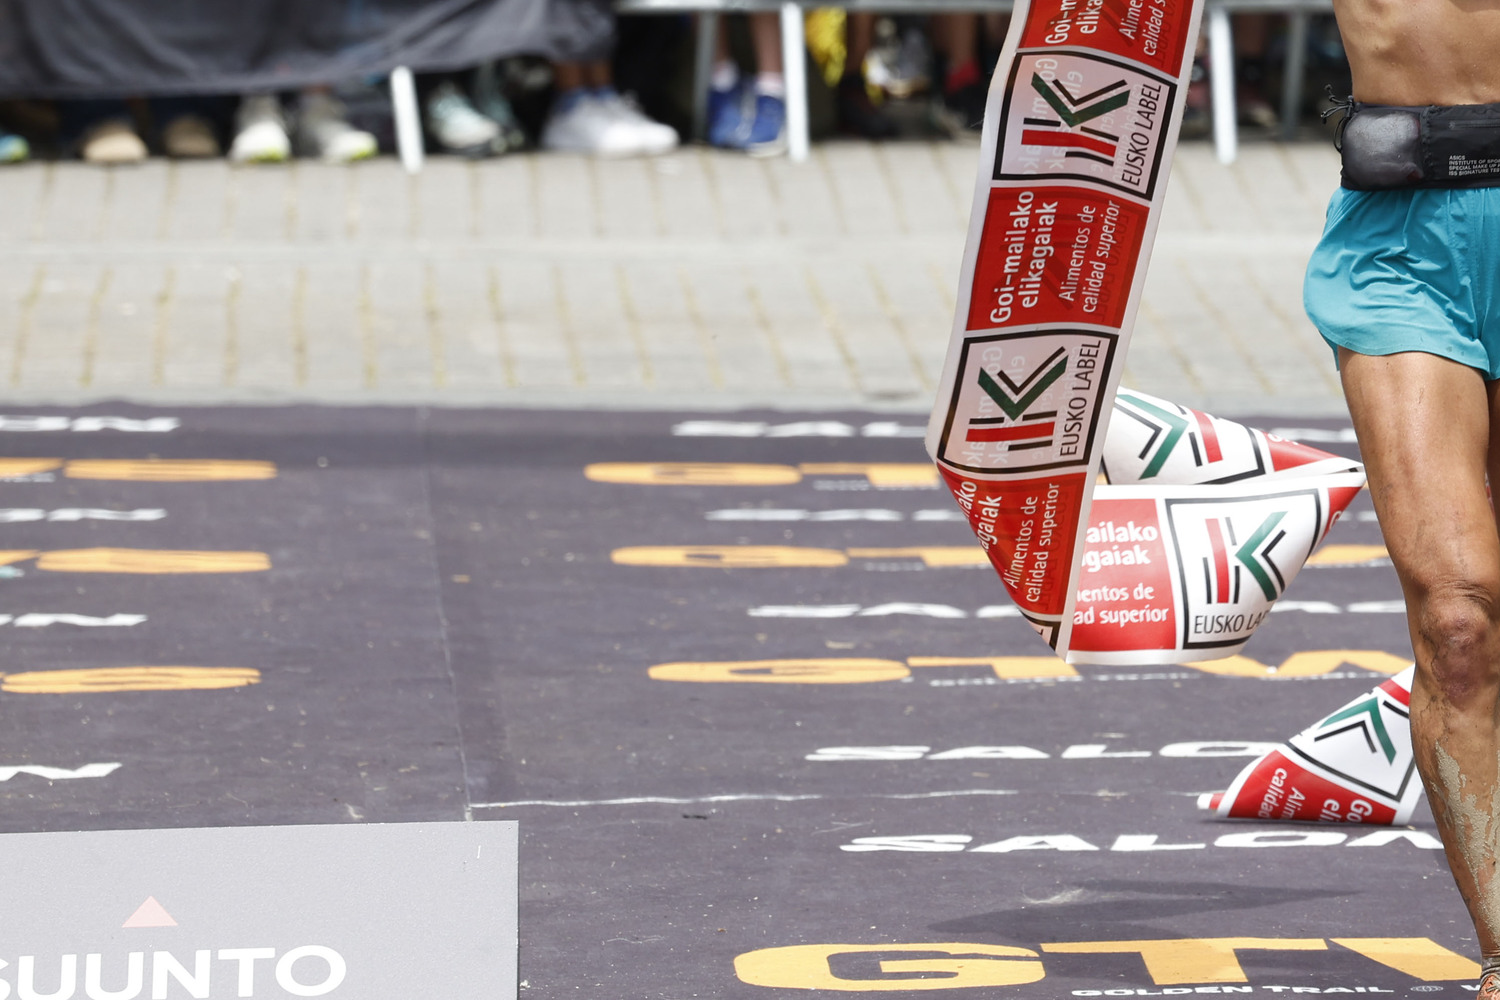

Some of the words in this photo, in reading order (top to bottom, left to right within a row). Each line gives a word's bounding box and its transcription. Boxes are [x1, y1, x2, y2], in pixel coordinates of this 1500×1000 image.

[1143, 3, 1164, 56] calidad
[1121, 132, 1148, 187] EUSKO
[1138, 84, 1162, 131] LABEL
[990, 191, 1034, 323] Goi-mailako
[1018, 201, 1058, 308] elikagaiak
[1058, 224, 1091, 301] Alimentos
[1080, 205, 1096, 222] de
[1083, 260, 1108, 313] calidad
[1096, 200, 1120, 260] superior
[1072, 340, 1101, 390] LABEL
[1060, 397, 1087, 456] EUSKO
[1004, 520, 1034, 589] Alimentos
[1021, 496, 1038, 515] de
[1025, 551, 1049, 602] calidad
[1039, 483, 1060, 546] superior
[1082, 544, 1151, 572] gaiak
[1085, 521, 1158, 543] ailako
[1077, 586, 1129, 602] entos
[1133, 582, 1155, 601] de
[1099, 604, 1169, 628] superior
[1194, 614, 1245, 634] EUSKO
[0, 944, 346, 1000] UUNTO
[1072, 985, 1253, 997] GOLDEN
[1262, 984, 1395, 995] TRAIL
